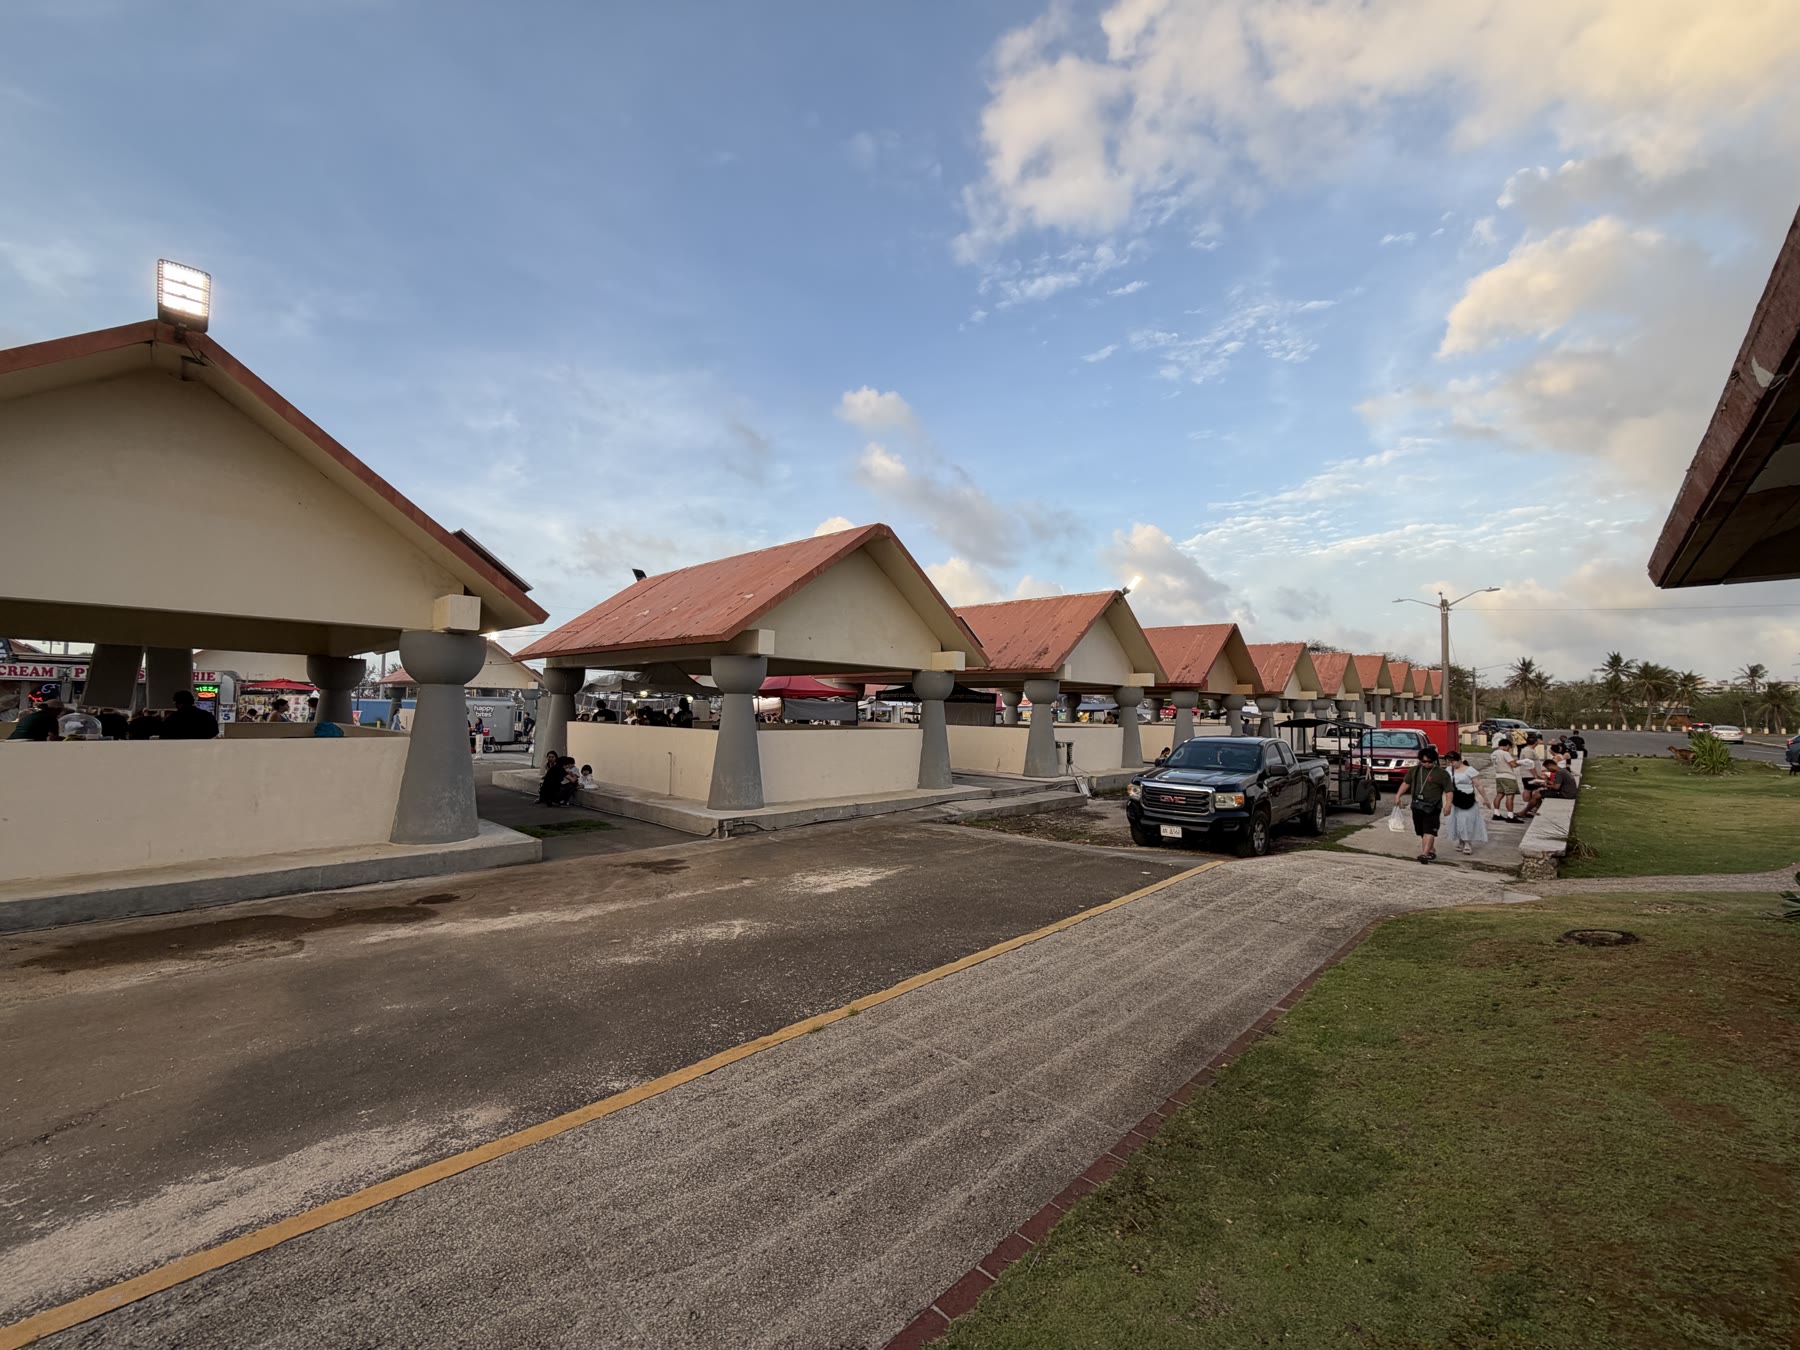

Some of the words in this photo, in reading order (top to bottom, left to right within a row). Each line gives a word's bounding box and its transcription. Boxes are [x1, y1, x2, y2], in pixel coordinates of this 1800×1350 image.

[0, 665, 54, 677] CREAM
[473, 704, 495, 712] happy
[1160, 795, 1186, 804] GMC
